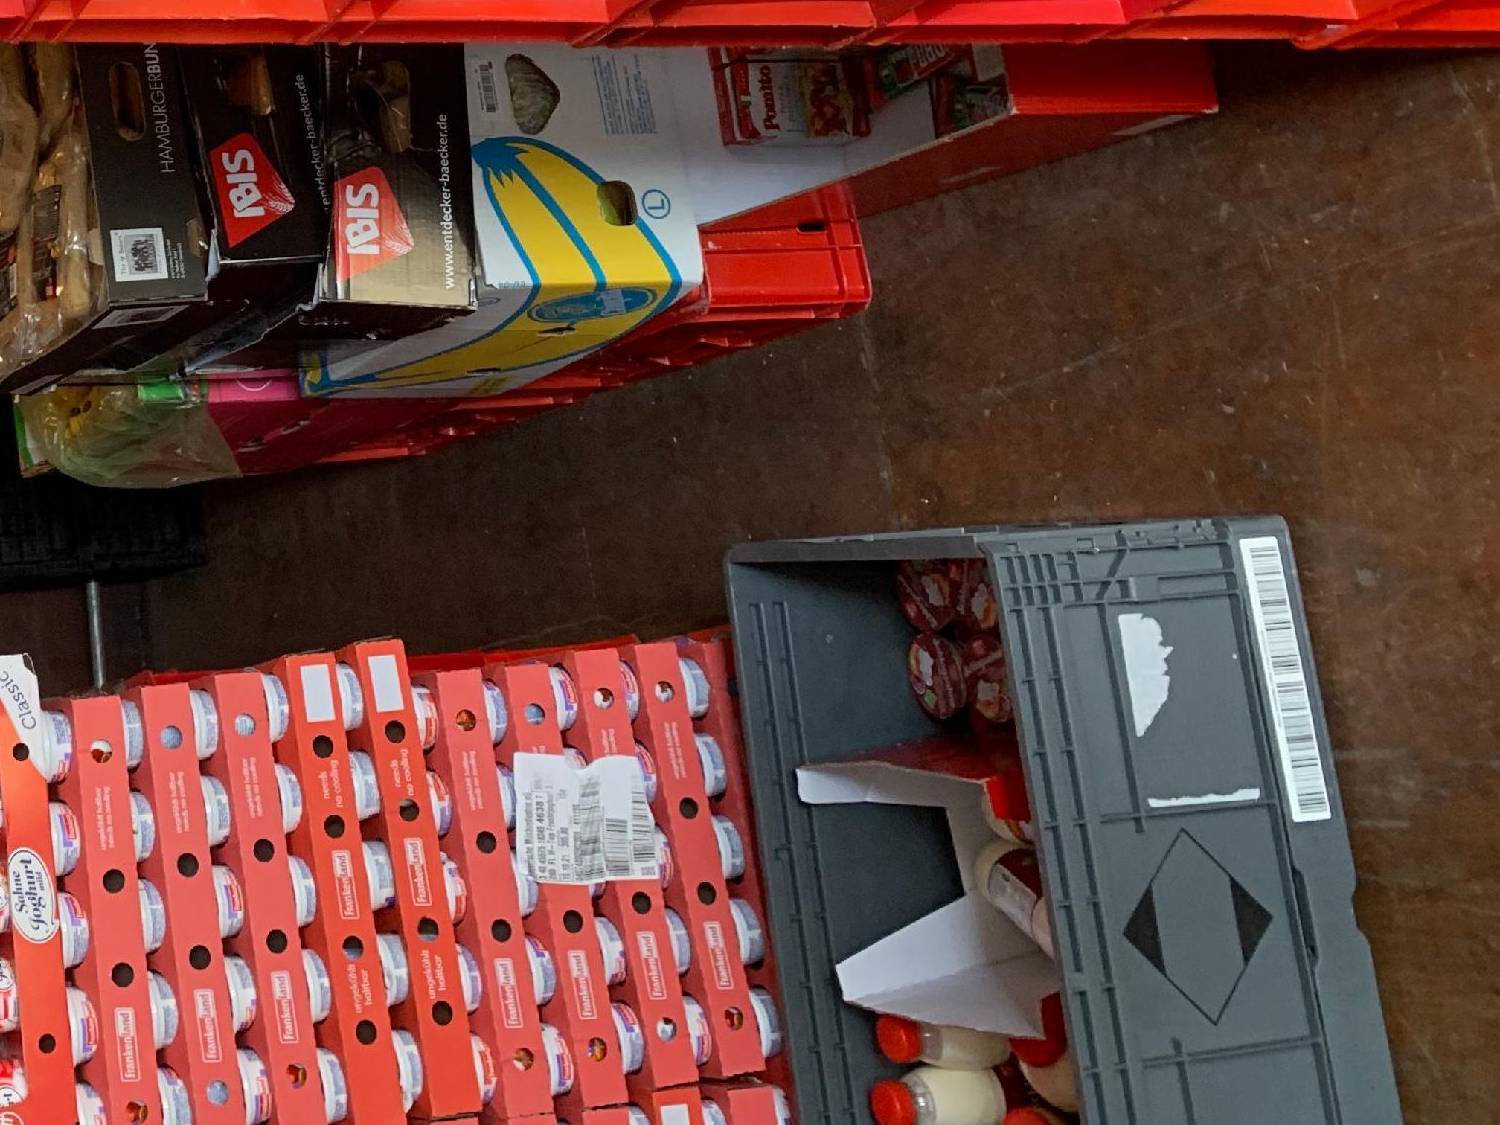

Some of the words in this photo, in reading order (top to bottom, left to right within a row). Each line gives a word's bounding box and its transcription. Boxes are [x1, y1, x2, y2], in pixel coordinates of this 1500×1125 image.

[221, 148, 266, 217] IBIS
[344, 184, 380, 255] IBIS
[436, 114, 456, 289] www.entdecker-baecker.de
[328, 760, 342, 794] cooling
[390, 759, 401, 788] needs
[400, 748, 413, 782] cooling
[319, 771, 331, 799] needs
[334, 795, 343, 808] no
[405, 784, 415, 796] no
[535, 801, 544, 824] 4638
[407, 840, 429, 904] Frankenland
[12, 871, 29, 914] Sahne
[20, 858, 48, 930] Joghurt
[348, 964, 363, 1013] ungekühlt
[360, 969, 373, 1005] haltbar
[421, 949, 436, 999] ungekühlt
[434, 955, 447, 991] haltbar
